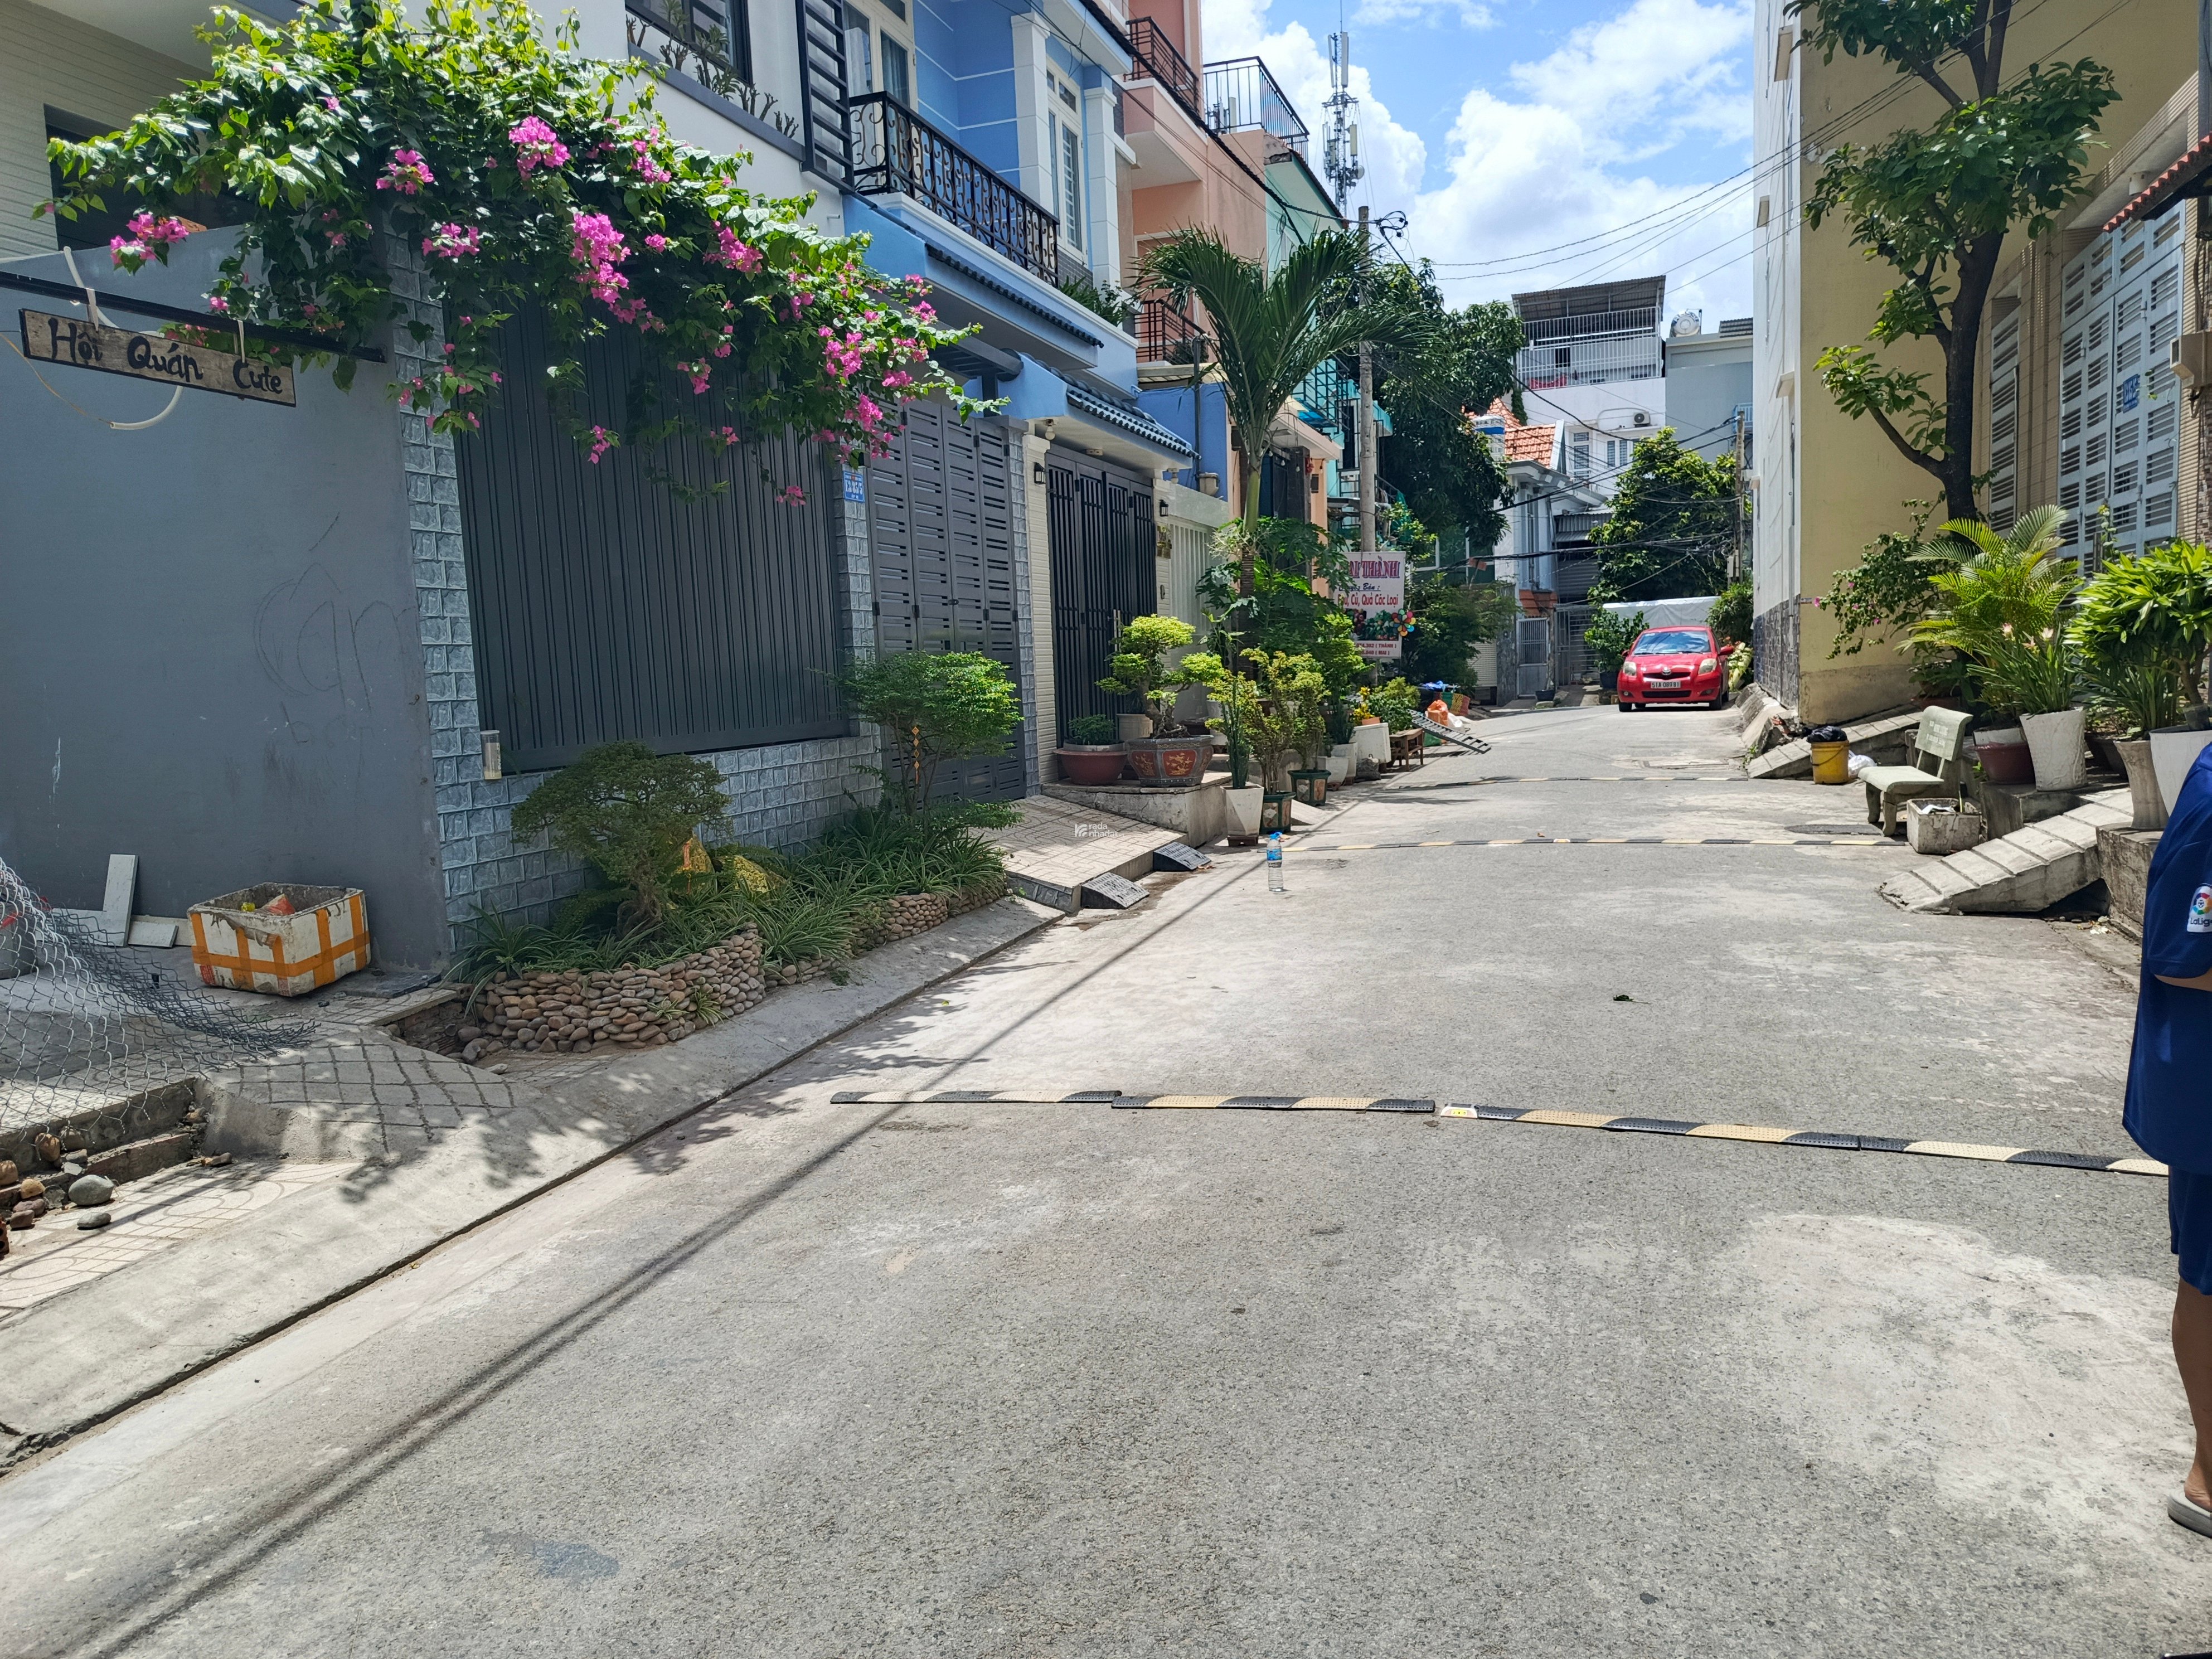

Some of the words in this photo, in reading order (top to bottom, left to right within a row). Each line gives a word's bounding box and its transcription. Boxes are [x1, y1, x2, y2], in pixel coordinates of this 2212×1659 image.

[48, 317, 103, 365] Hội
[127, 336, 203, 383] Quán
[232, 358, 283, 394] Cute
[1362, 555, 1400, 579] THÀNH
[1351, 592, 1360, 607] Củ,
[1362, 592, 1373, 605] Quả
[1375, 594, 1385, 605] Các
[1387, 594, 1398, 608] Loại
[2190, 918, 2212, 927] LaLig
